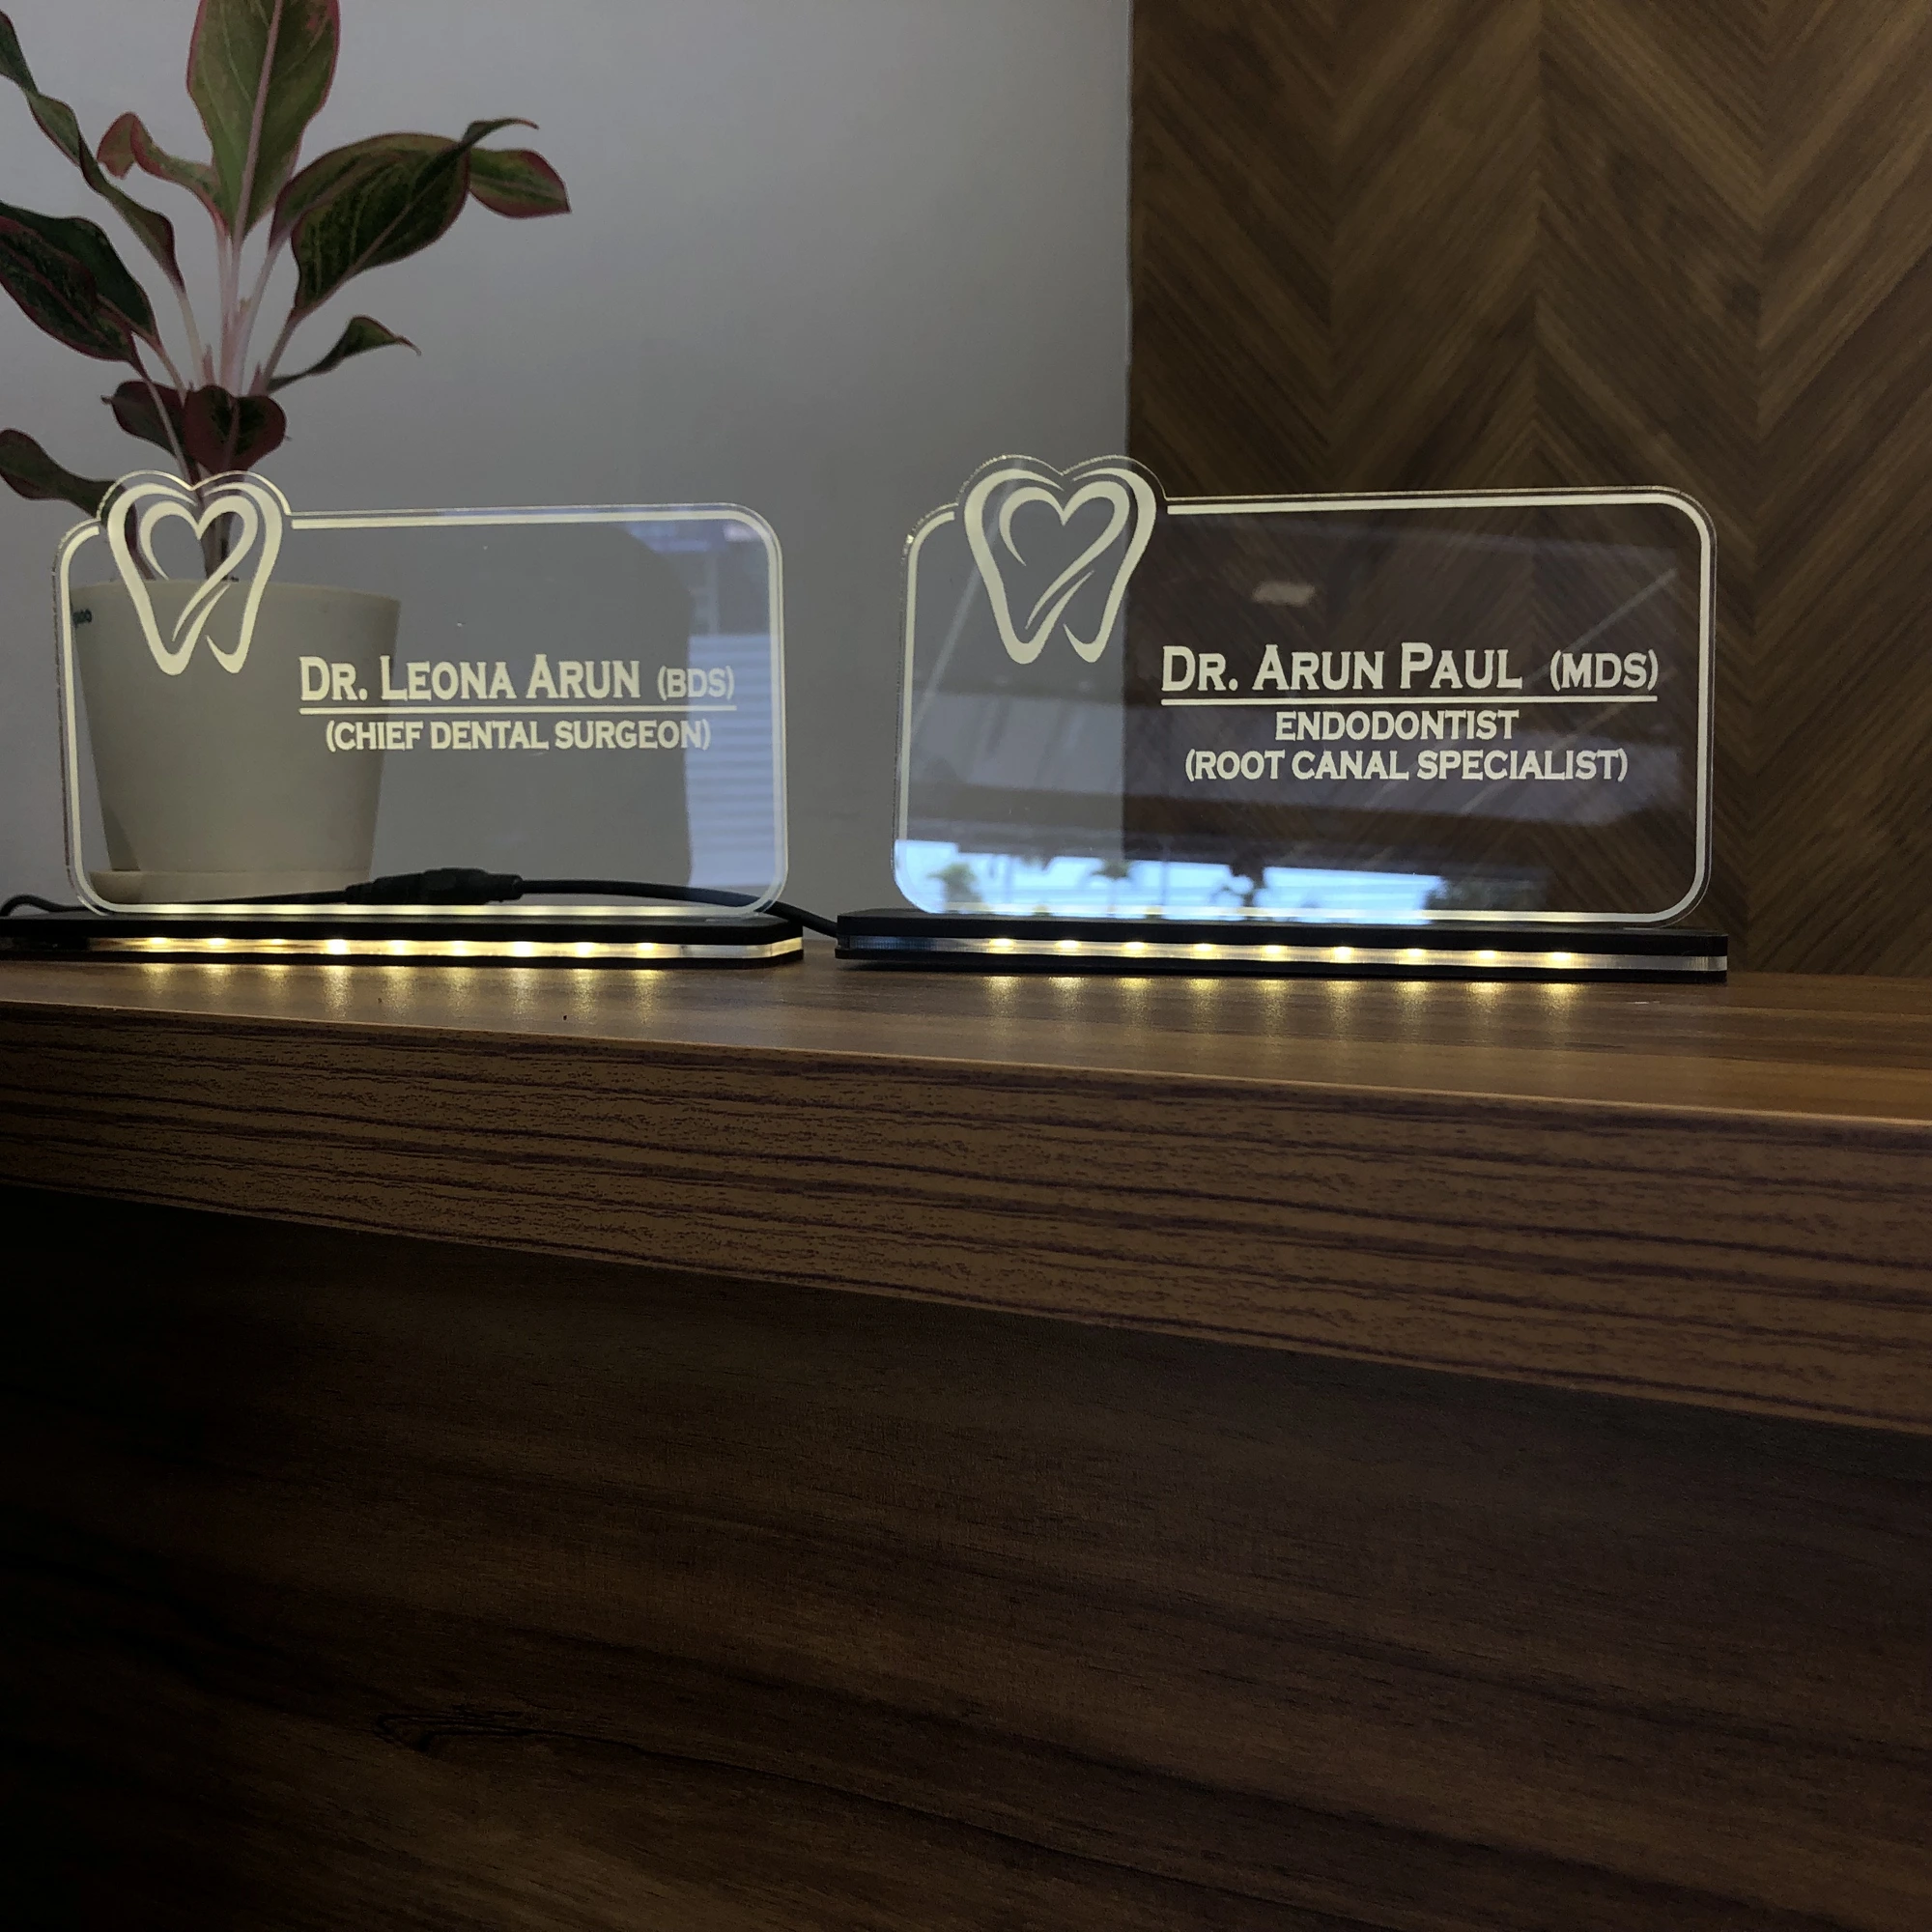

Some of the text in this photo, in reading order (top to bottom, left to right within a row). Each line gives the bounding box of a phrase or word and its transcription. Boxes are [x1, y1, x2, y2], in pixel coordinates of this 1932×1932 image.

[657, 665, 735, 701] (BDS)
[1549, 649, 1659, 692] (MDS)
[325, 719, 712, 753] (CHIEF DENTAL SURGEON)
[1274, 710, 1520, 741] ENDODONTIST
[1185, 747, 1629, 782] (ROOT CANAL SPECIALIST)
